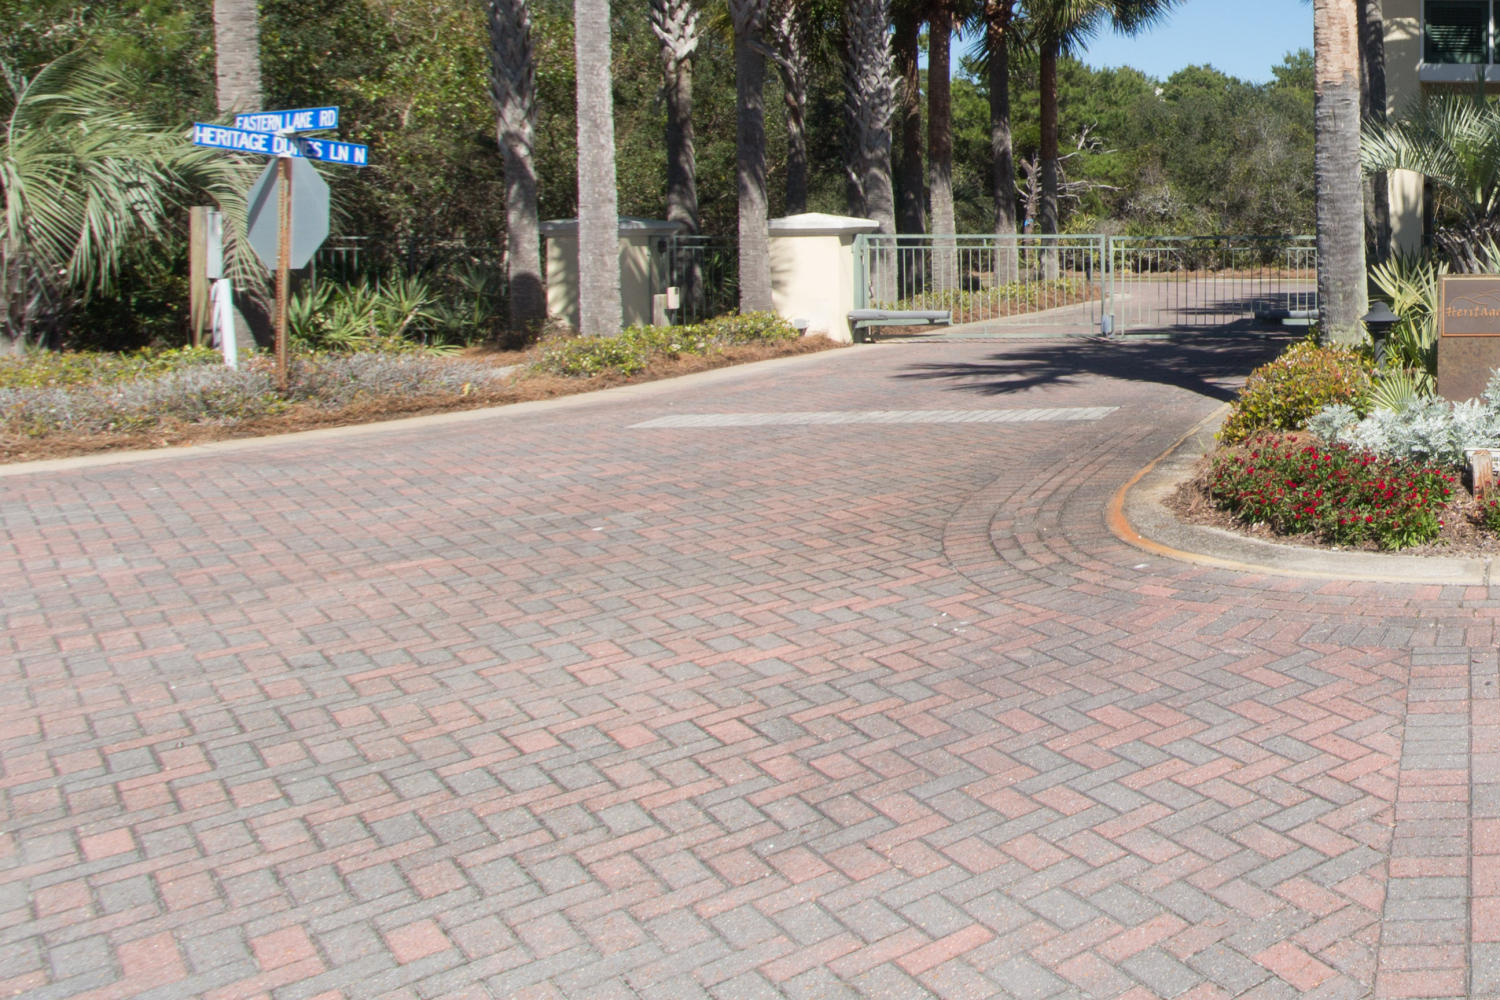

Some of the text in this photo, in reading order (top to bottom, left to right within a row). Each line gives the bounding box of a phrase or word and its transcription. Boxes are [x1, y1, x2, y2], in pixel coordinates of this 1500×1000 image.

[236, 109, 336, 132] EASTERN LAKE RD
[195, 125, 366, 164] HERITAGE DUNES LN N
